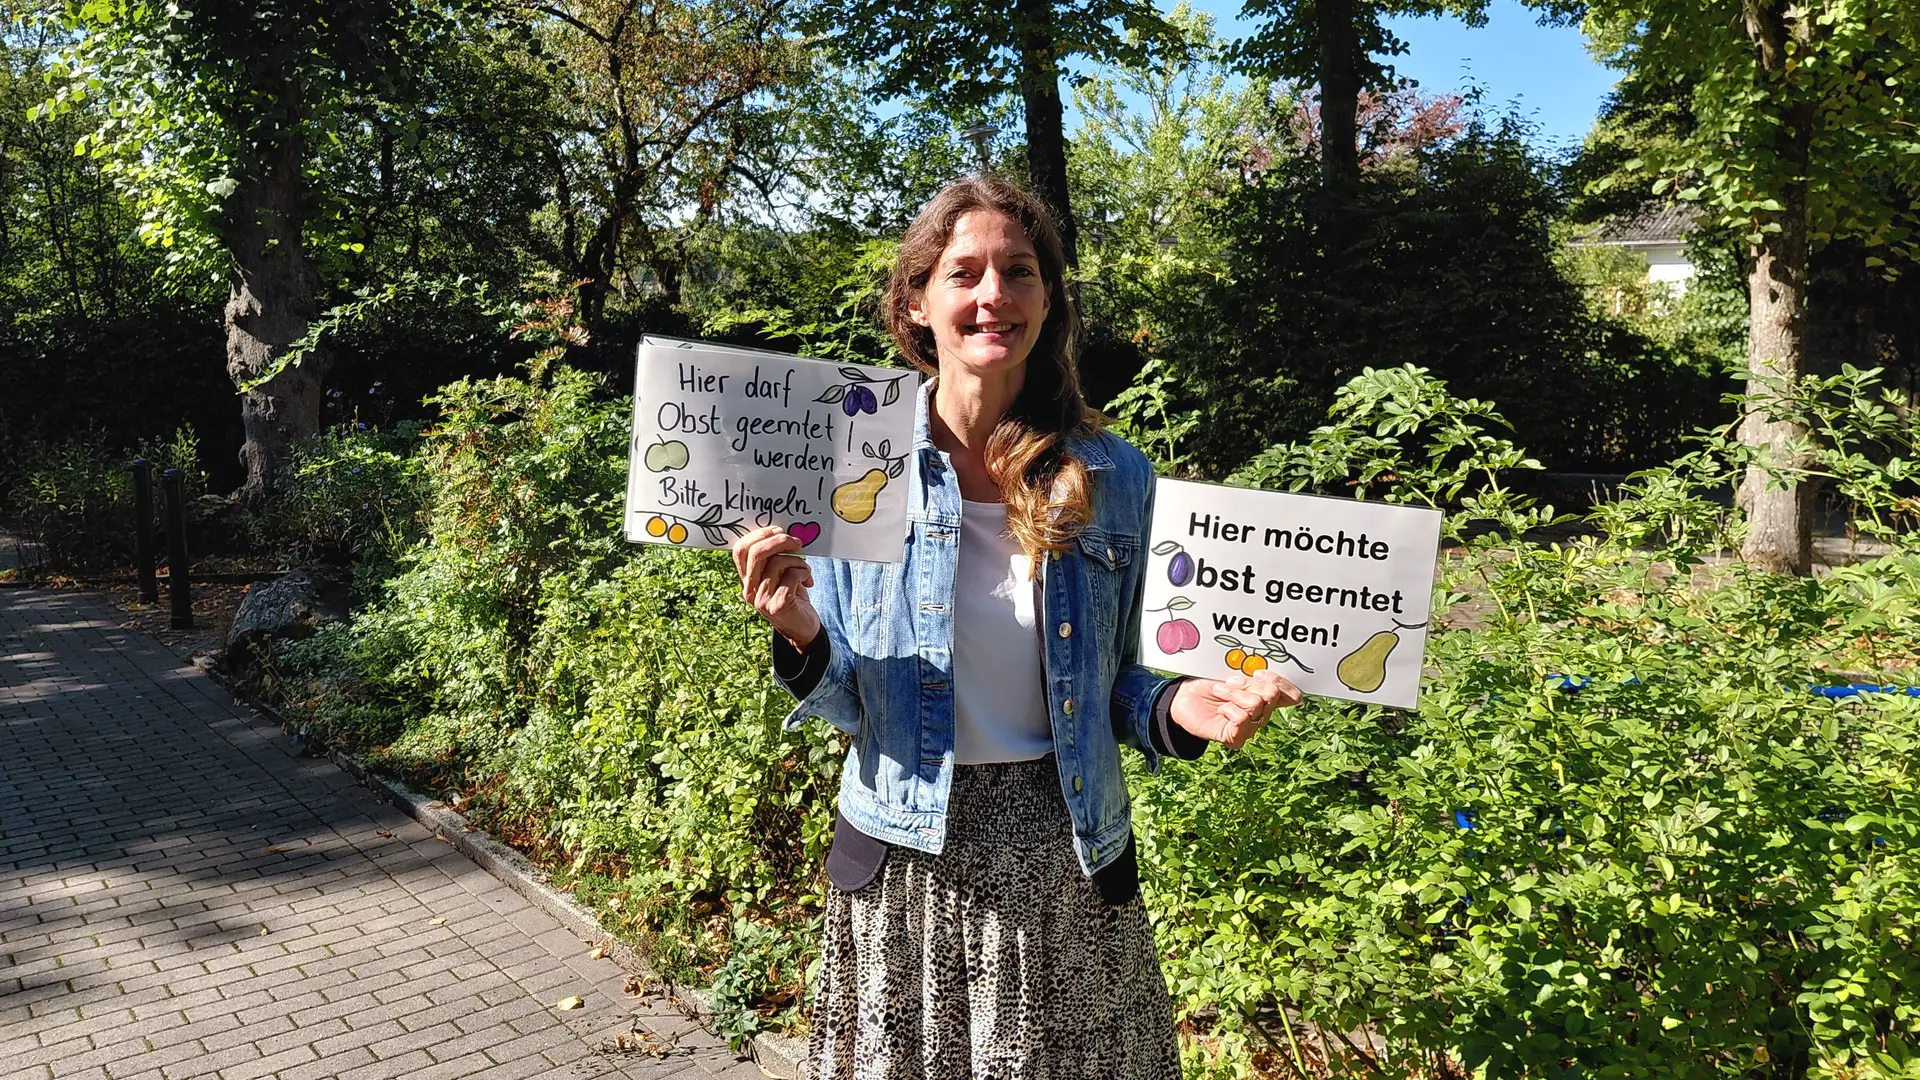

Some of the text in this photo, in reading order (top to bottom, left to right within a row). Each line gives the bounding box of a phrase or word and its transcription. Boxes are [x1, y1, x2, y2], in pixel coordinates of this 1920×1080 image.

[678, 363, 795, 408] Hier darf
[657, 401, 834, 452] Obst geerntet
[753, 443, 835, 472] werden
[657, 476, 825, 528] Bitte klingeln!
[1188, 512, 1390, 561] Hier möchte
[1264, 578, 1404, 614] geerntet
[1211, 611, 1340, 648] werden!
